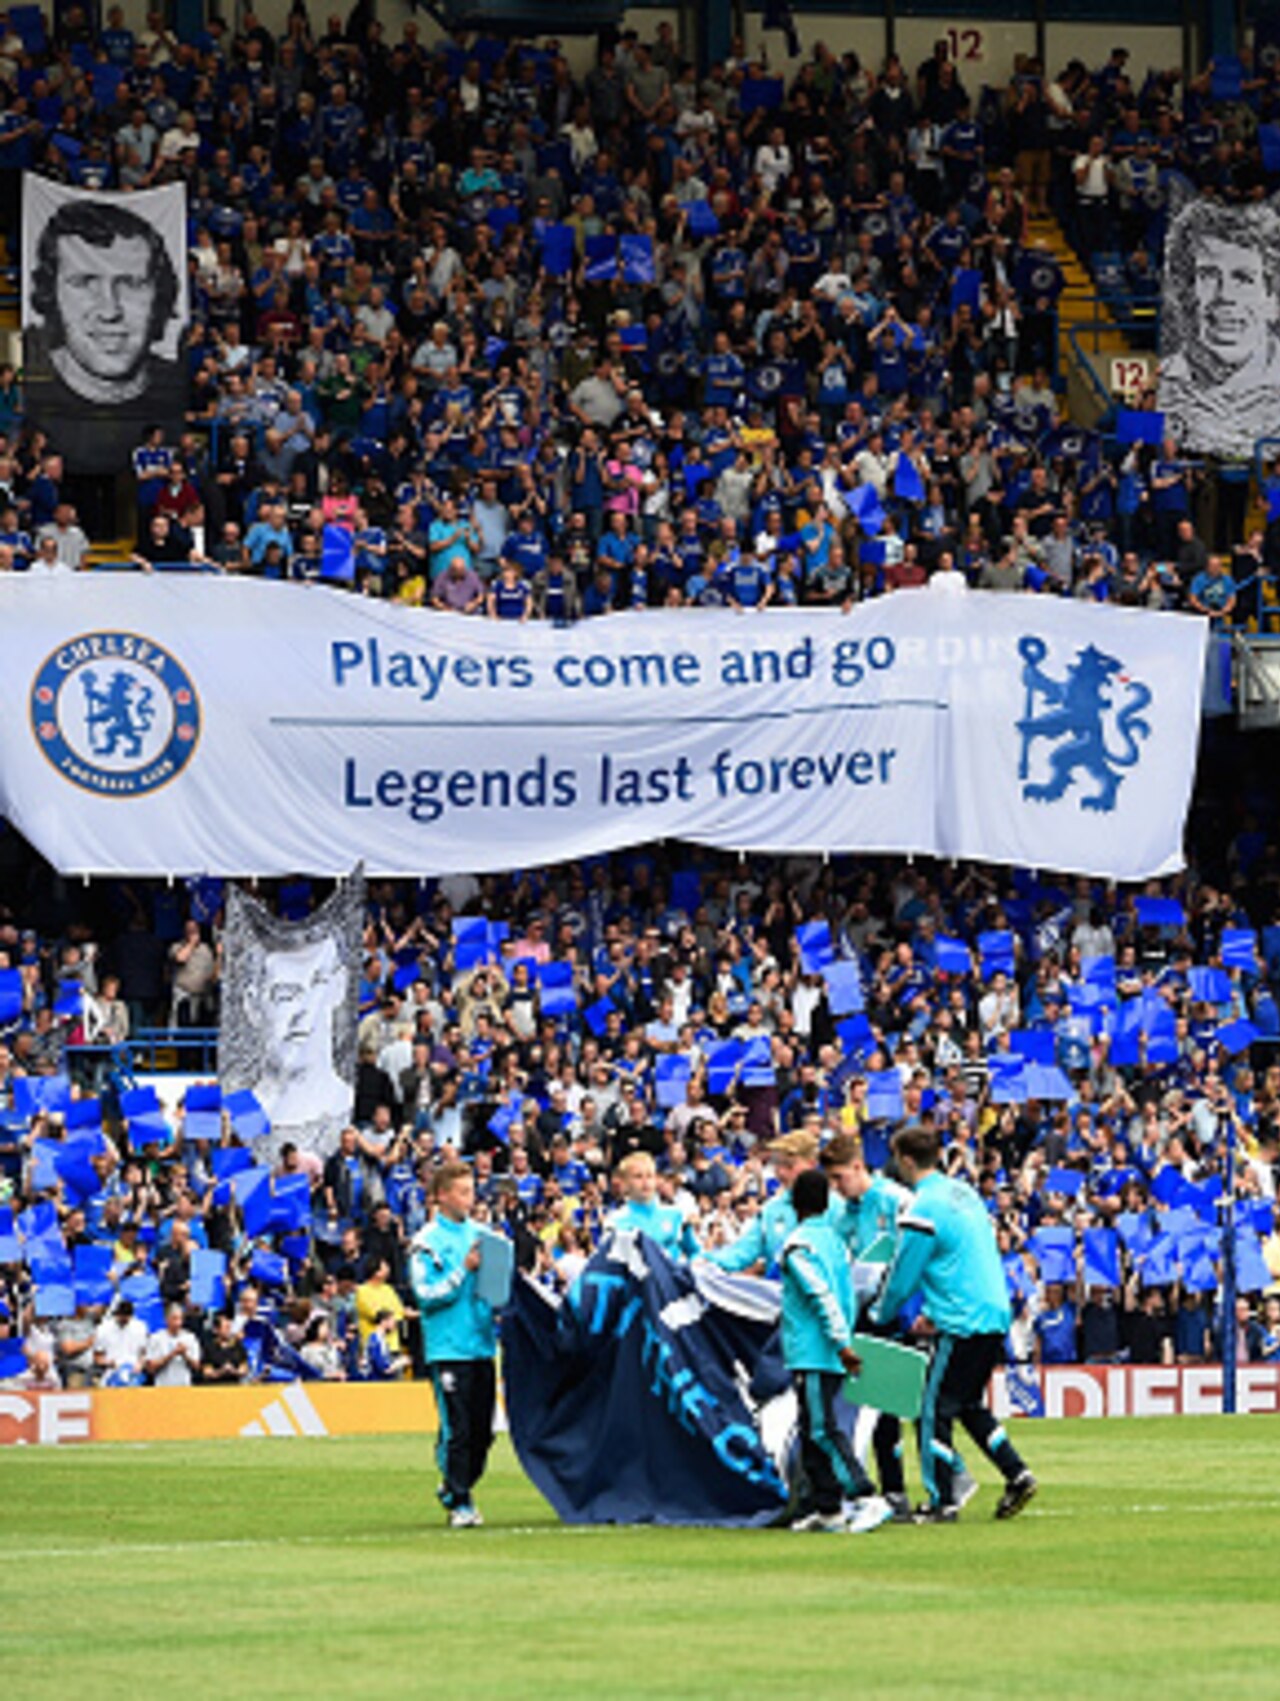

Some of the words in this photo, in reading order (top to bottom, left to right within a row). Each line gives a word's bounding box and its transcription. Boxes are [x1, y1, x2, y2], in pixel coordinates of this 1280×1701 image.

[947, 28, 983, 61] 12
[1115, 362, 1144, 388] 12
[56, 636, 165, 671] CHELSEA
[331, 637, 534, 701] Players
[554, 653, 700, 688] come
[720, 636, 813, 685] and
[831, 635, 897, 687] go
[344, 754, 577, 823] Legends
[600, 754, 694, 805] last
[711, 747, 898, 798] forever
